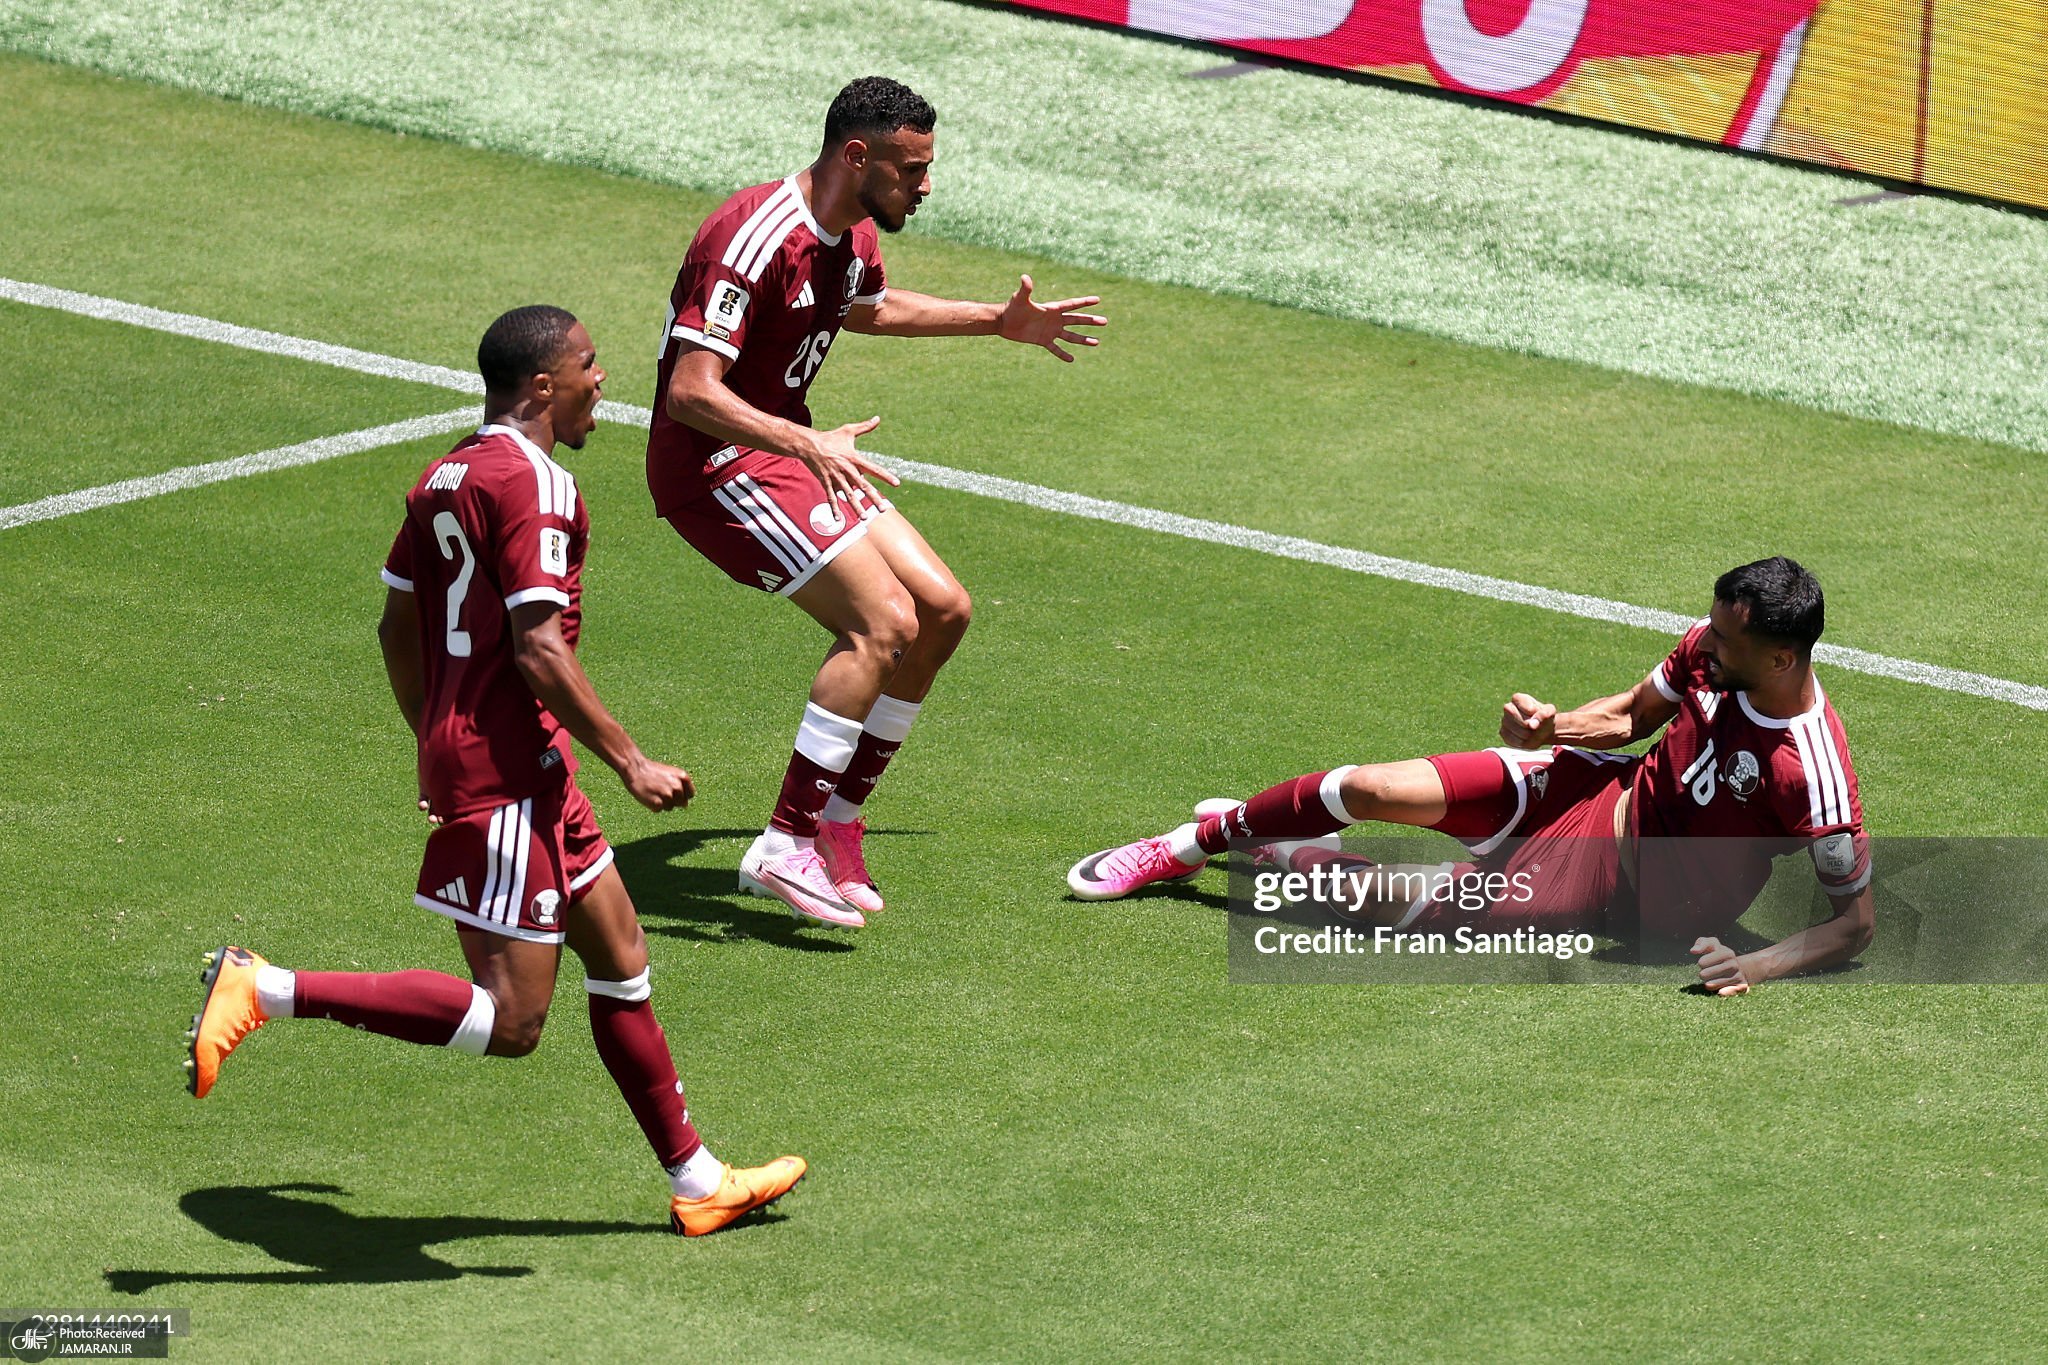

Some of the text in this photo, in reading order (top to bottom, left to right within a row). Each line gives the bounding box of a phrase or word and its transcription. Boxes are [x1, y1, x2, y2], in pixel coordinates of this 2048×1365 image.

[784, 331, 831, 388] 26
[433, 511, 475, 658] 2
[1681, 738, 1724, 806] 16
